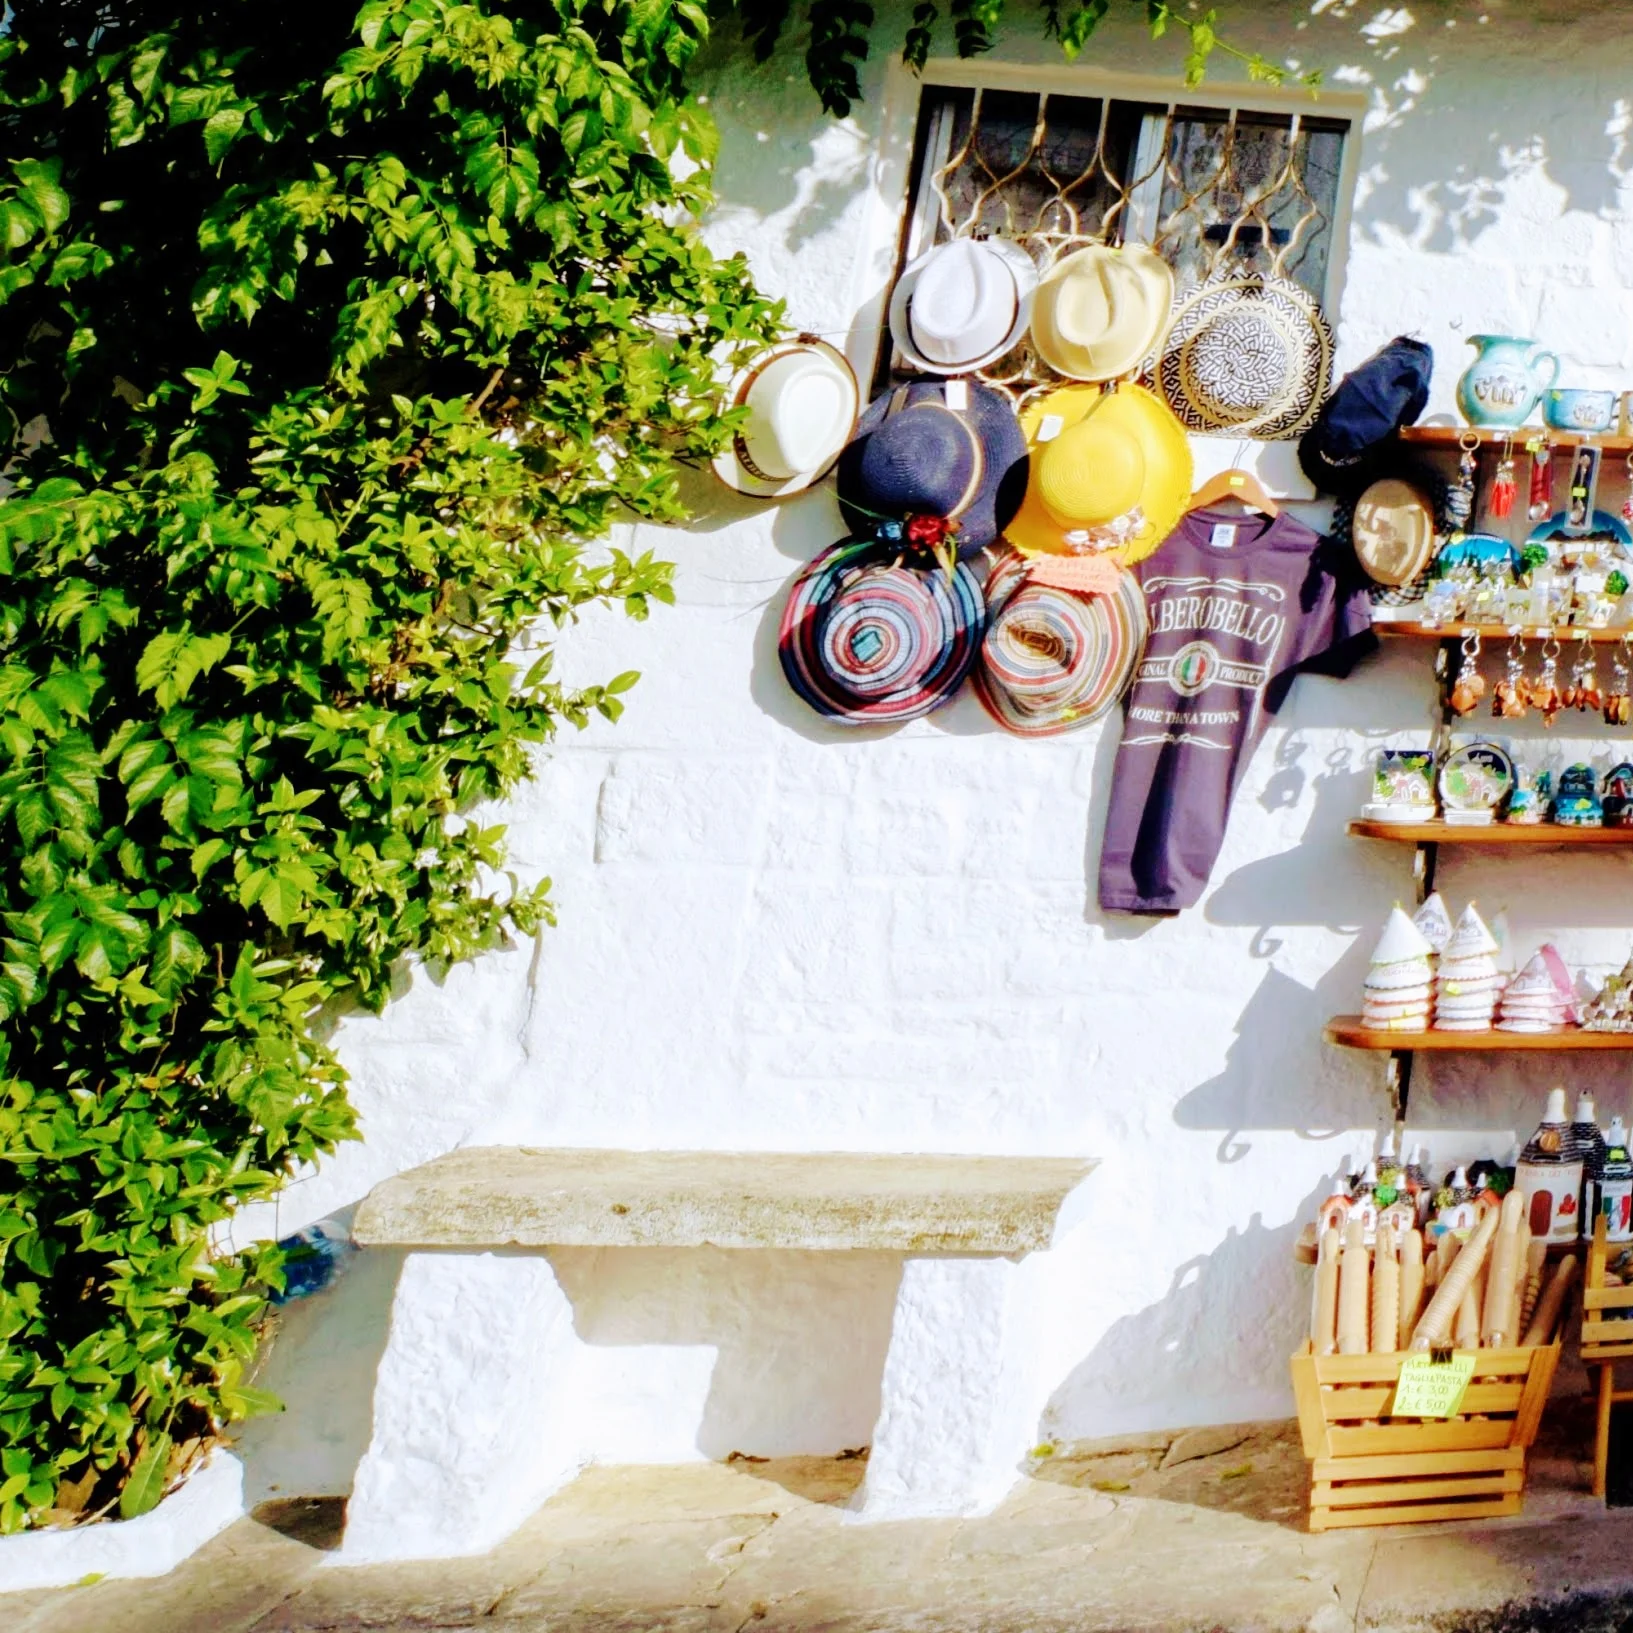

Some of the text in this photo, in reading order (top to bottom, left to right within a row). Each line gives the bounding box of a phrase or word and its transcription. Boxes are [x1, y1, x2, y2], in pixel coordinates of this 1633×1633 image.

[1149, 595, 1279, 646] LBEROBELLO
[1219, 666, 1263, 685] PRODUCT
[1200, 710, 1240, 725] TOWN
